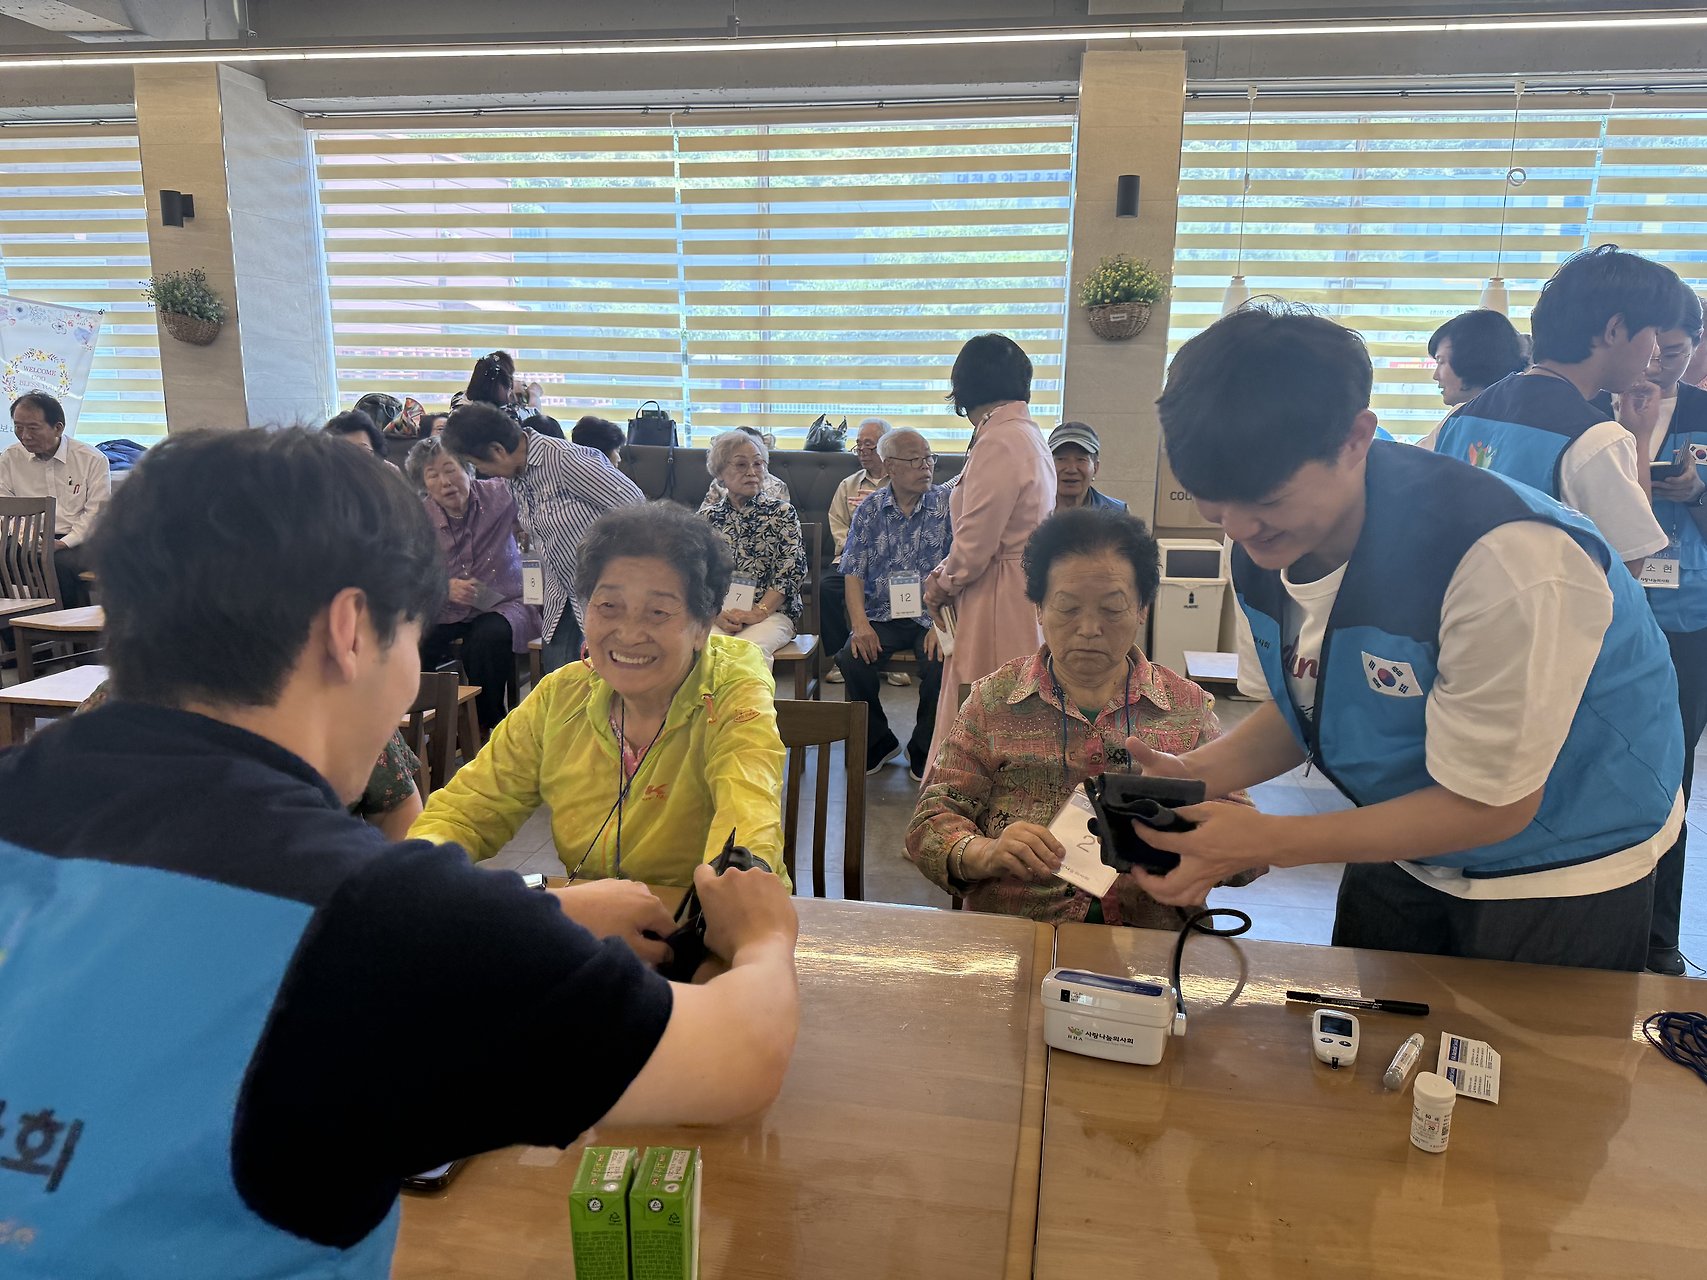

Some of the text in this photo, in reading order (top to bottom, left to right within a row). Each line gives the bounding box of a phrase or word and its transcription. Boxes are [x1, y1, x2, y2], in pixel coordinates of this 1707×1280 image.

[23, 365, 57, 377] WELCOME
[735, 592, 742, 602] 7
[900, 593, 911, 602] 12
[1076, 835, 1096, 853] 2
[1084, 1030, 1134, 1045] 사랑나눔의사회
[0, 1100, 85, 1194] 회
